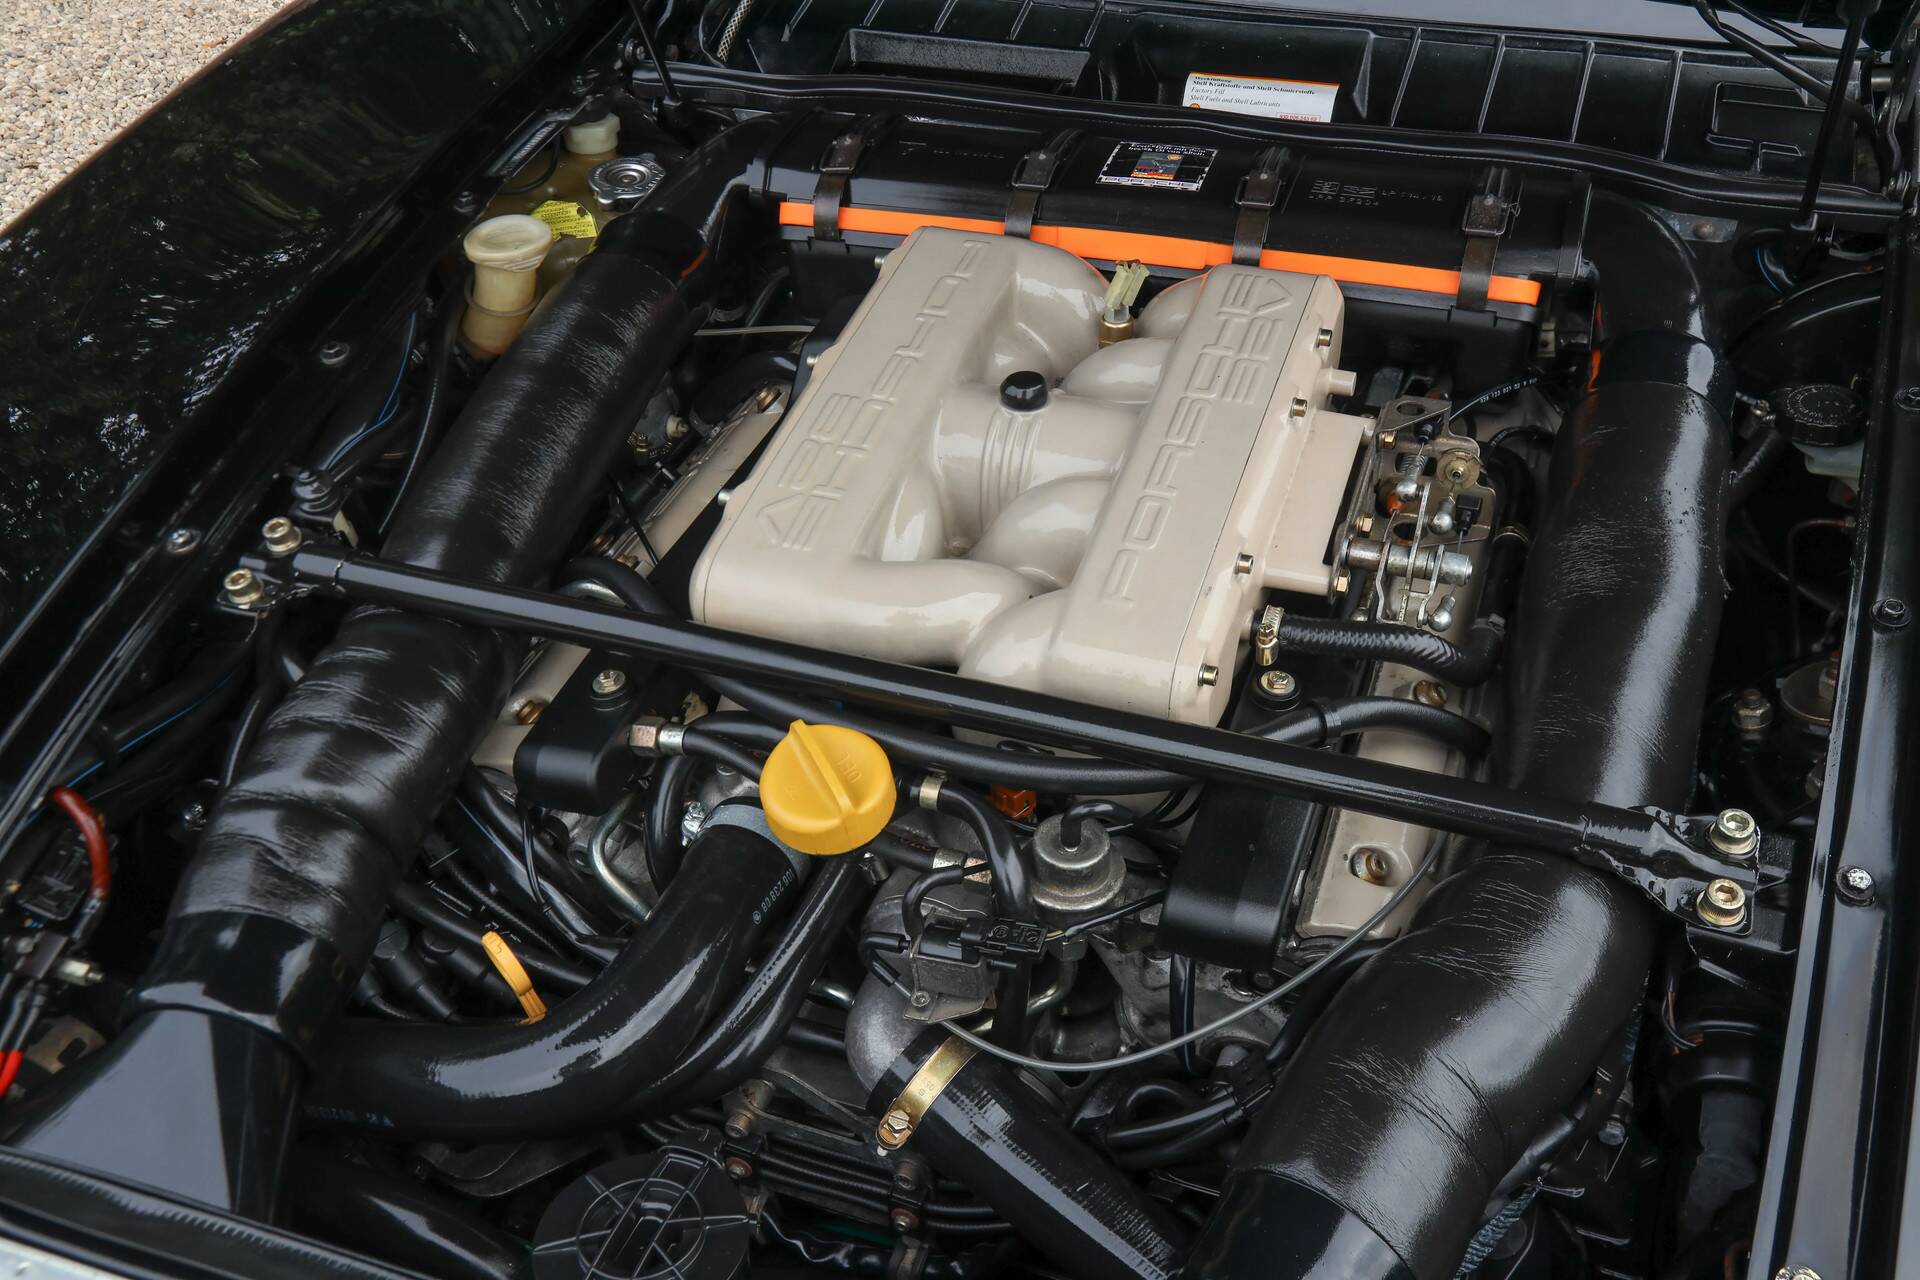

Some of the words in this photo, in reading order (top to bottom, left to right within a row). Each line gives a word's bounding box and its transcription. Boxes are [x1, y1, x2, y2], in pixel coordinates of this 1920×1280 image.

[1190, 94, 1204, 102] Shell
[1191, 86, 1213, 95] Factory
[781, 239, 992, 551] PORSCHE
[1219, 277, 1294, 405] 32V
[756, 392, 861, 545] 32V
[1101, 272, 1262, 608] PORSCHE
